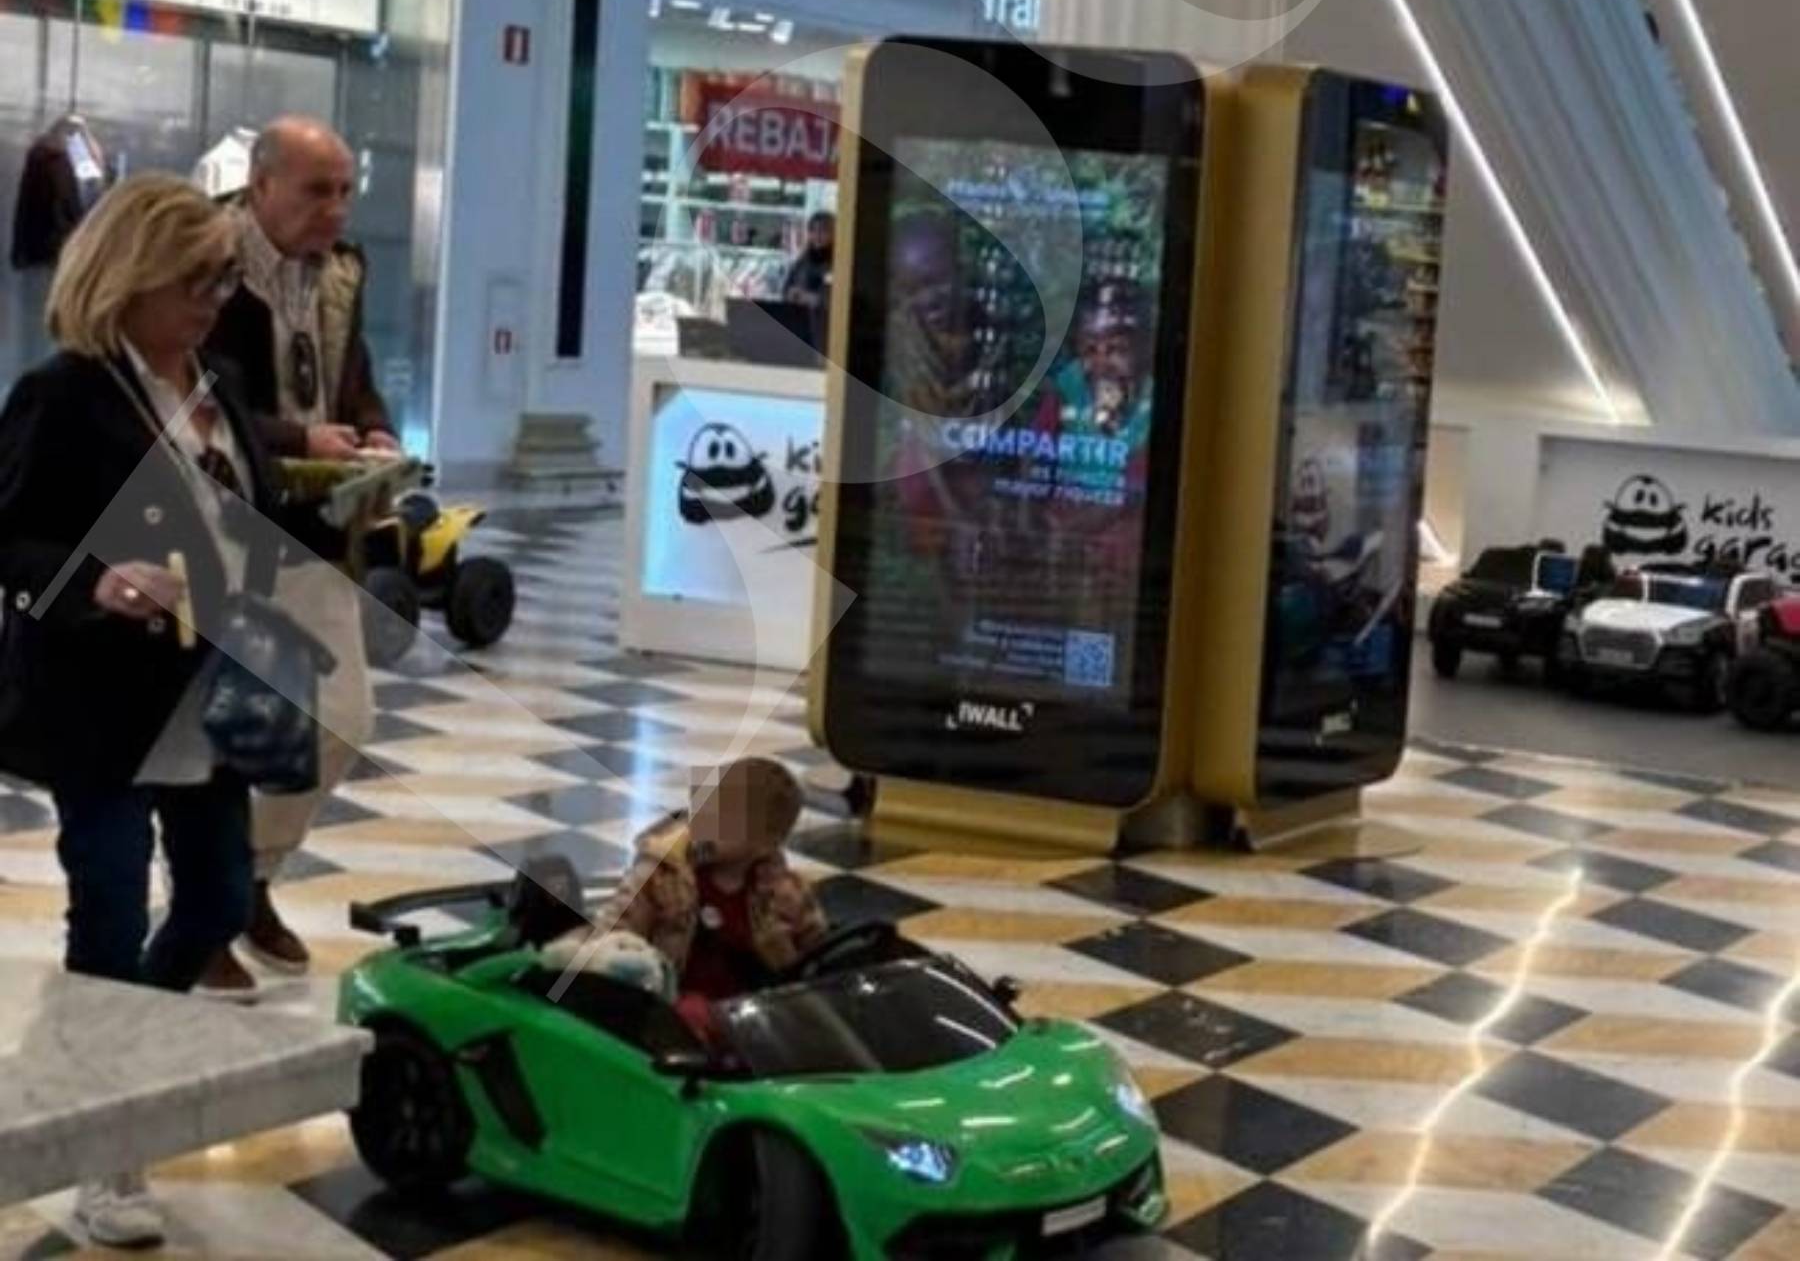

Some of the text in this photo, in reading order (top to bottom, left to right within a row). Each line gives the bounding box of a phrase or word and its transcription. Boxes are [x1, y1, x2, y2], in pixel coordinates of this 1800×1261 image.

[941, 420, 1130, 468] COMPARTIR
[1701, 492, 1776, 533] kids
[957, 700, 1024, 732] IWALL
